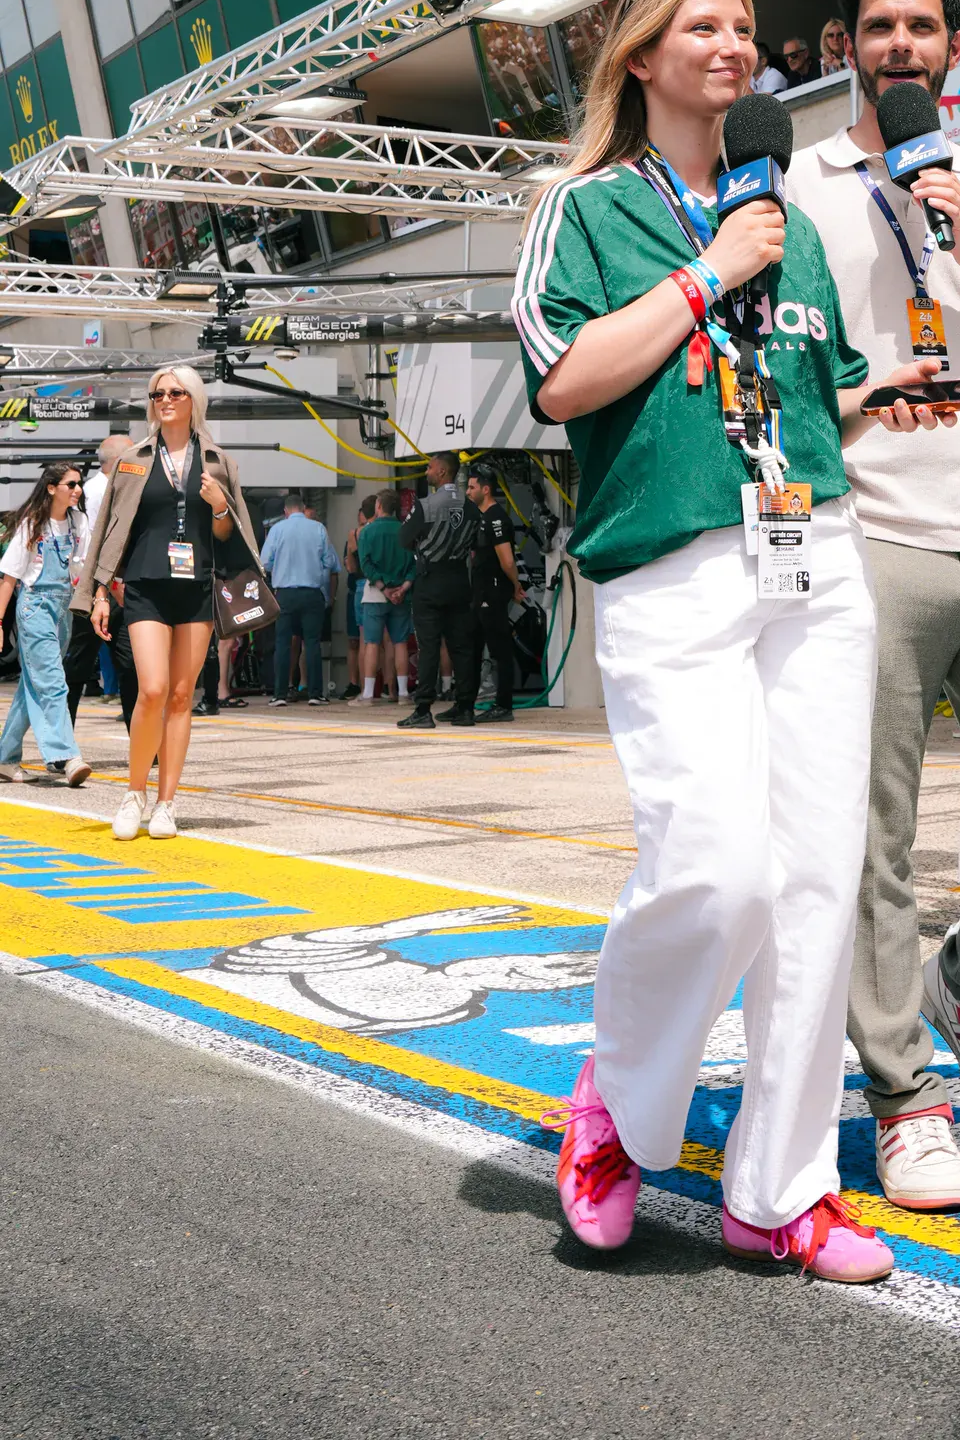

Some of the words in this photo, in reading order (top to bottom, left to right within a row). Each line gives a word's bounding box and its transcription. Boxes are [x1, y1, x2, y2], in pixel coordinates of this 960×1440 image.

[9, 120, 60, 166] ROLEX
[897, 149, 939, 171] MICHELIN
[642, 158, 681, 207] PORSCHE
[722, 180, 761, 203] MICHELIN
[289, 321, 359, 330] PEUGEOT
[290, 330, 360, 341] TotalEnergies
[34, 403, 90, 411] PEUGEOT
[34, 410, 90, 419] TotalEnergies
[445, 414, 465, 436] 94
